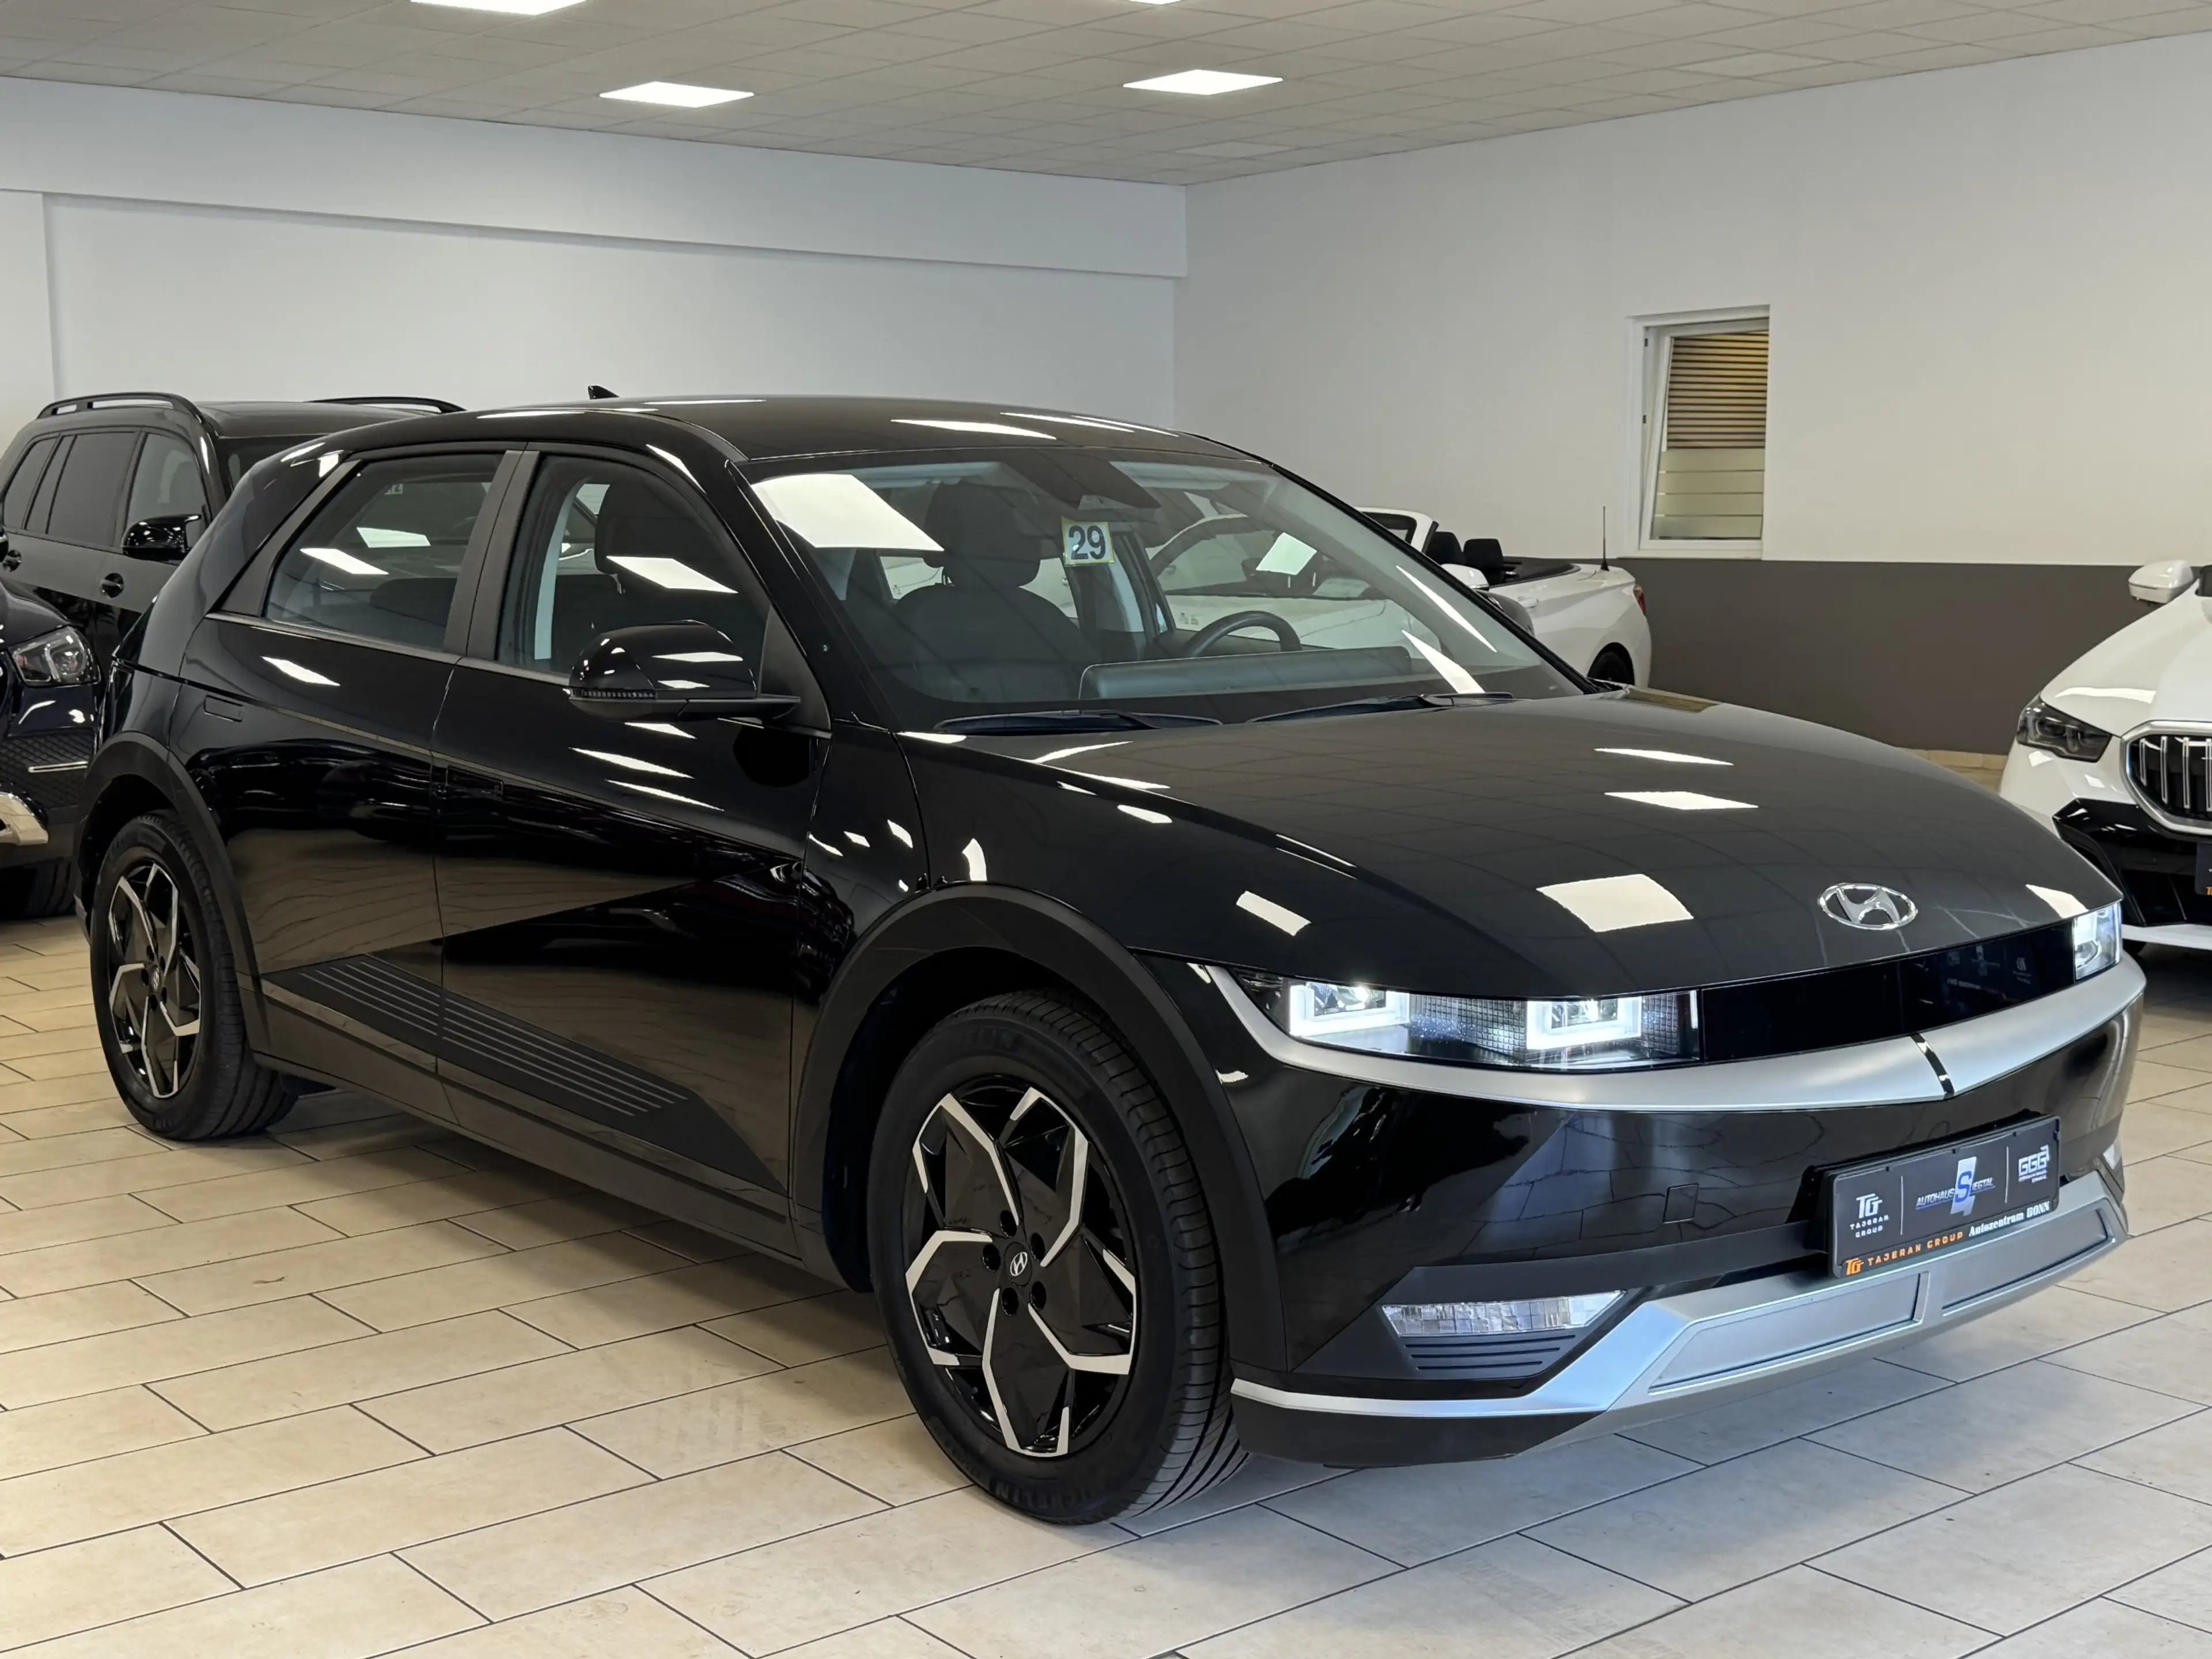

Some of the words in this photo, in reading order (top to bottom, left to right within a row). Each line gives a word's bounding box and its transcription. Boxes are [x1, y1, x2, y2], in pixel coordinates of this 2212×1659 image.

[1069, 525, 1106, 560] 29
[1916, 1187, 1956, 1207] AUTOHAUS
[1850, 1214, 1889, 1230] TAJERAN
[1855, 1225, 1883, 1237] GROUP
[1868, 1243, 1922, 1266] TAJERAN
[1926, 1231, 1964, 1249] GROUP
[1968, 1212, 2024, 1237] Autozentrum
[2027, 1200, 2050, 1218] BONN
